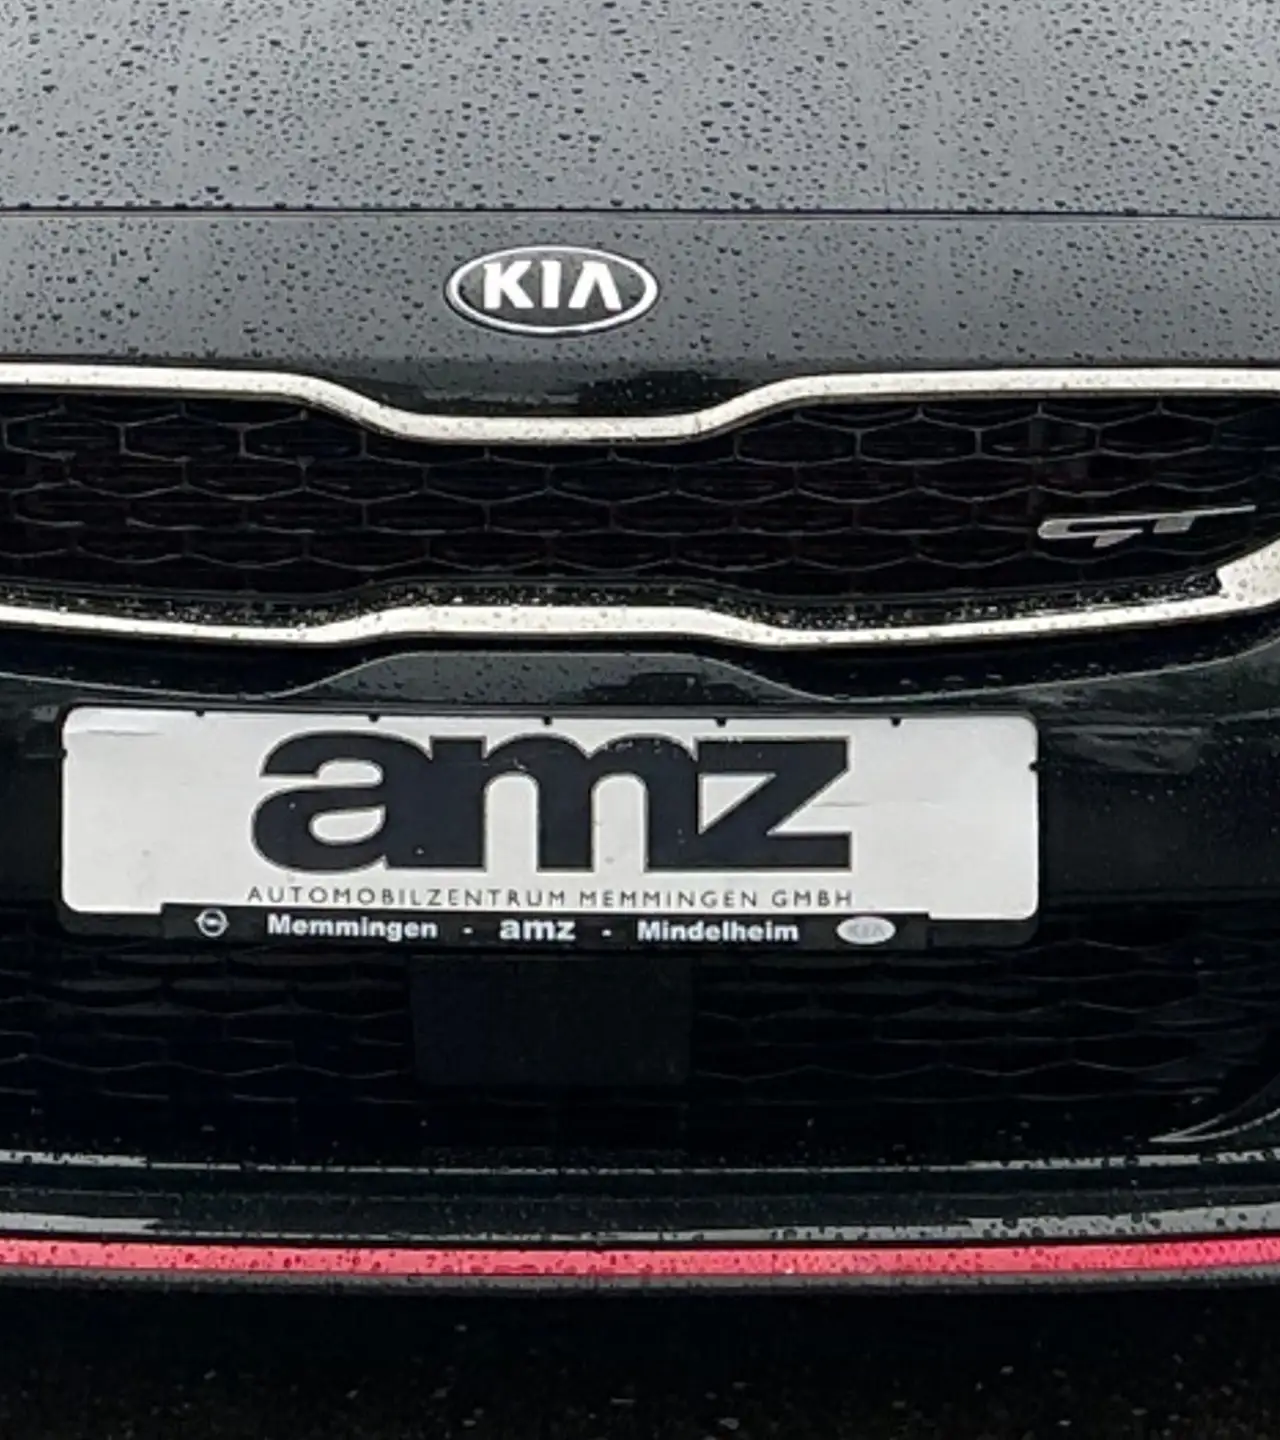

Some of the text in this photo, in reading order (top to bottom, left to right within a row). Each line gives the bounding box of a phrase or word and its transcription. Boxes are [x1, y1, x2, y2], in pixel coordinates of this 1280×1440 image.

[482, 259, 623, 311] KIA
[1037, 504, 1258, 549] GT
[251, 729, 853, 874] amz
[247, 885, 853, 909] AUTOMOBILZENTRUM MEMMINGEN GMBH
[266, 912, 438, 942] Memmingen
[499, 918, 576, 942] amz
[637, 919, 800, 943] Mindelheim
